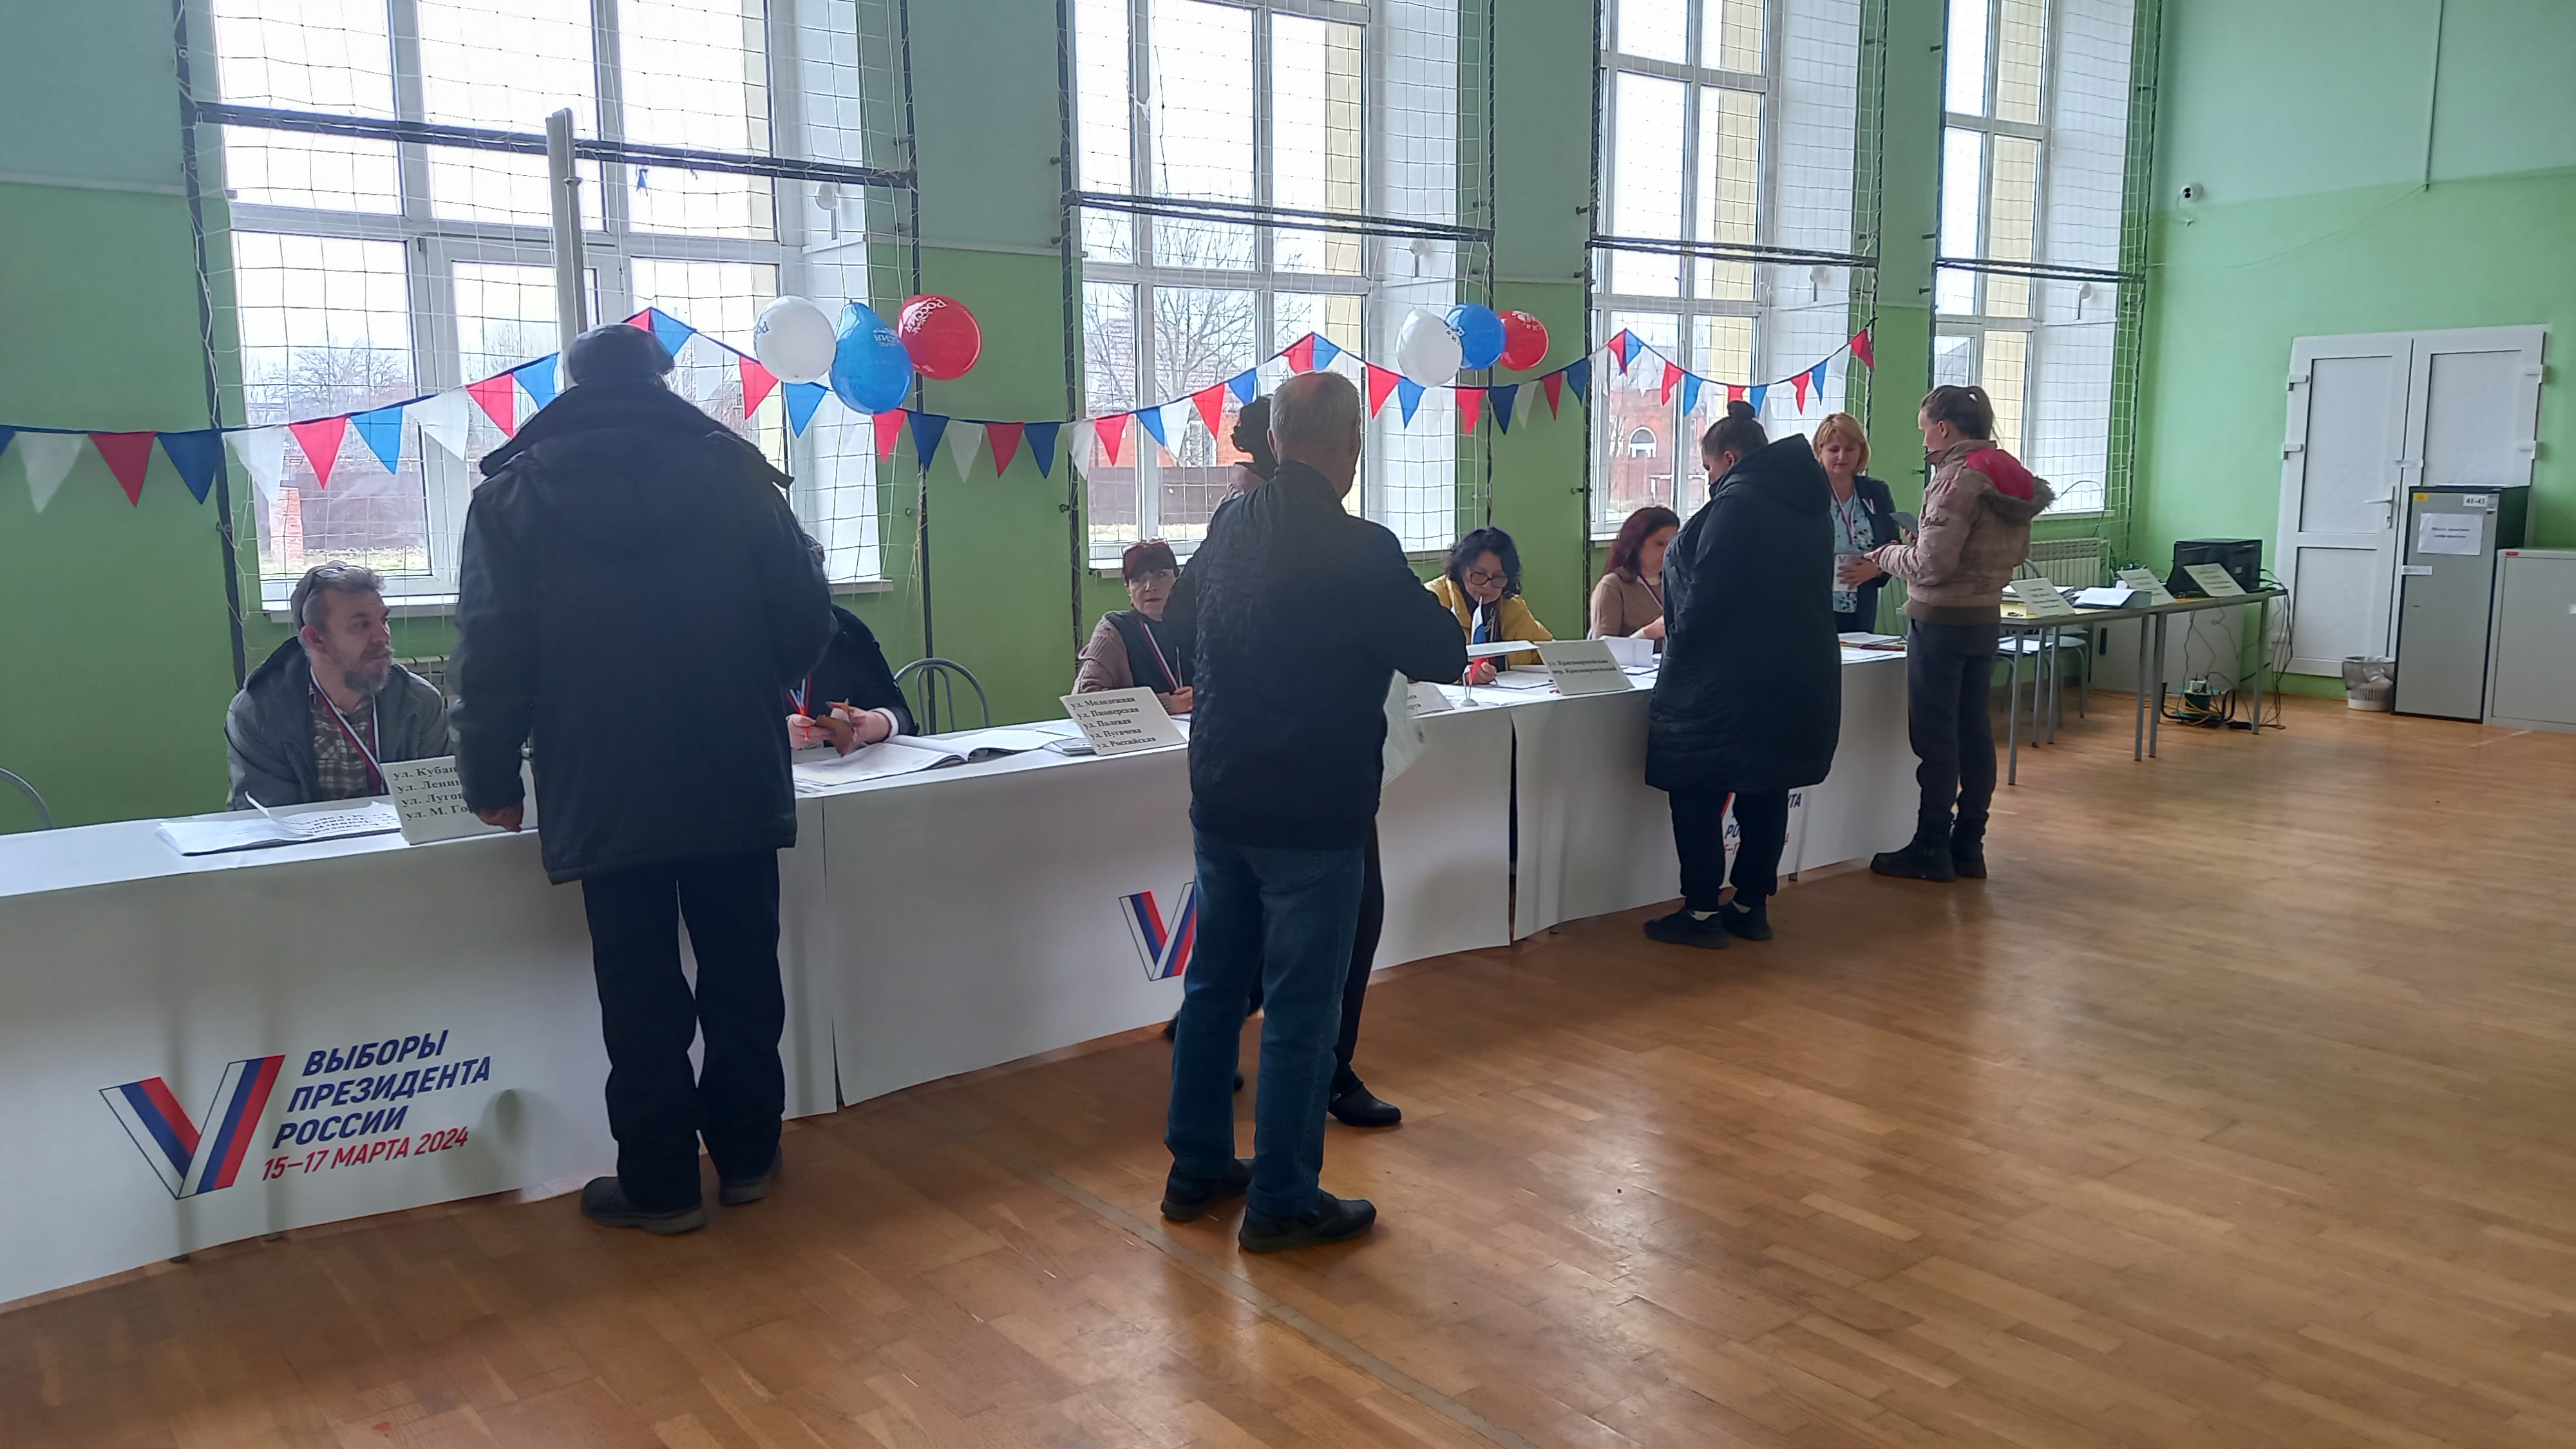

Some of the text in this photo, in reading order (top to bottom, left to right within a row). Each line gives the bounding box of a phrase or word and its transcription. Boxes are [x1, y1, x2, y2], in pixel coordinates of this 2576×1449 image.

[1084, 697, 1135, 706] Молодежная
[1090, 708, 1139, 717] Пионерская
[1096, 719, 1132, 727] Полевая
[1103, 728, 1142, 737] Пугачева
[1109, 737, 1157, 747] Российская
[393, 766, 457, 781] ул. Кубан
[397, 785, 417, 794] ул.
[401, 799, 422, 808] ул.
[406, 812, 426, 821] ул.
[429, 807, 448, 816] М.
[303, 1030, 449, 1076] ВЫБОРЫ
[287, 1056, 491, 1113] ПРЕЗИДЕНТА
[272, 1105, 408, 1149] РОССИИ
[332, 1136, 410, 1170] МАРТА
[413, 1126, 469, 1156] 2024
